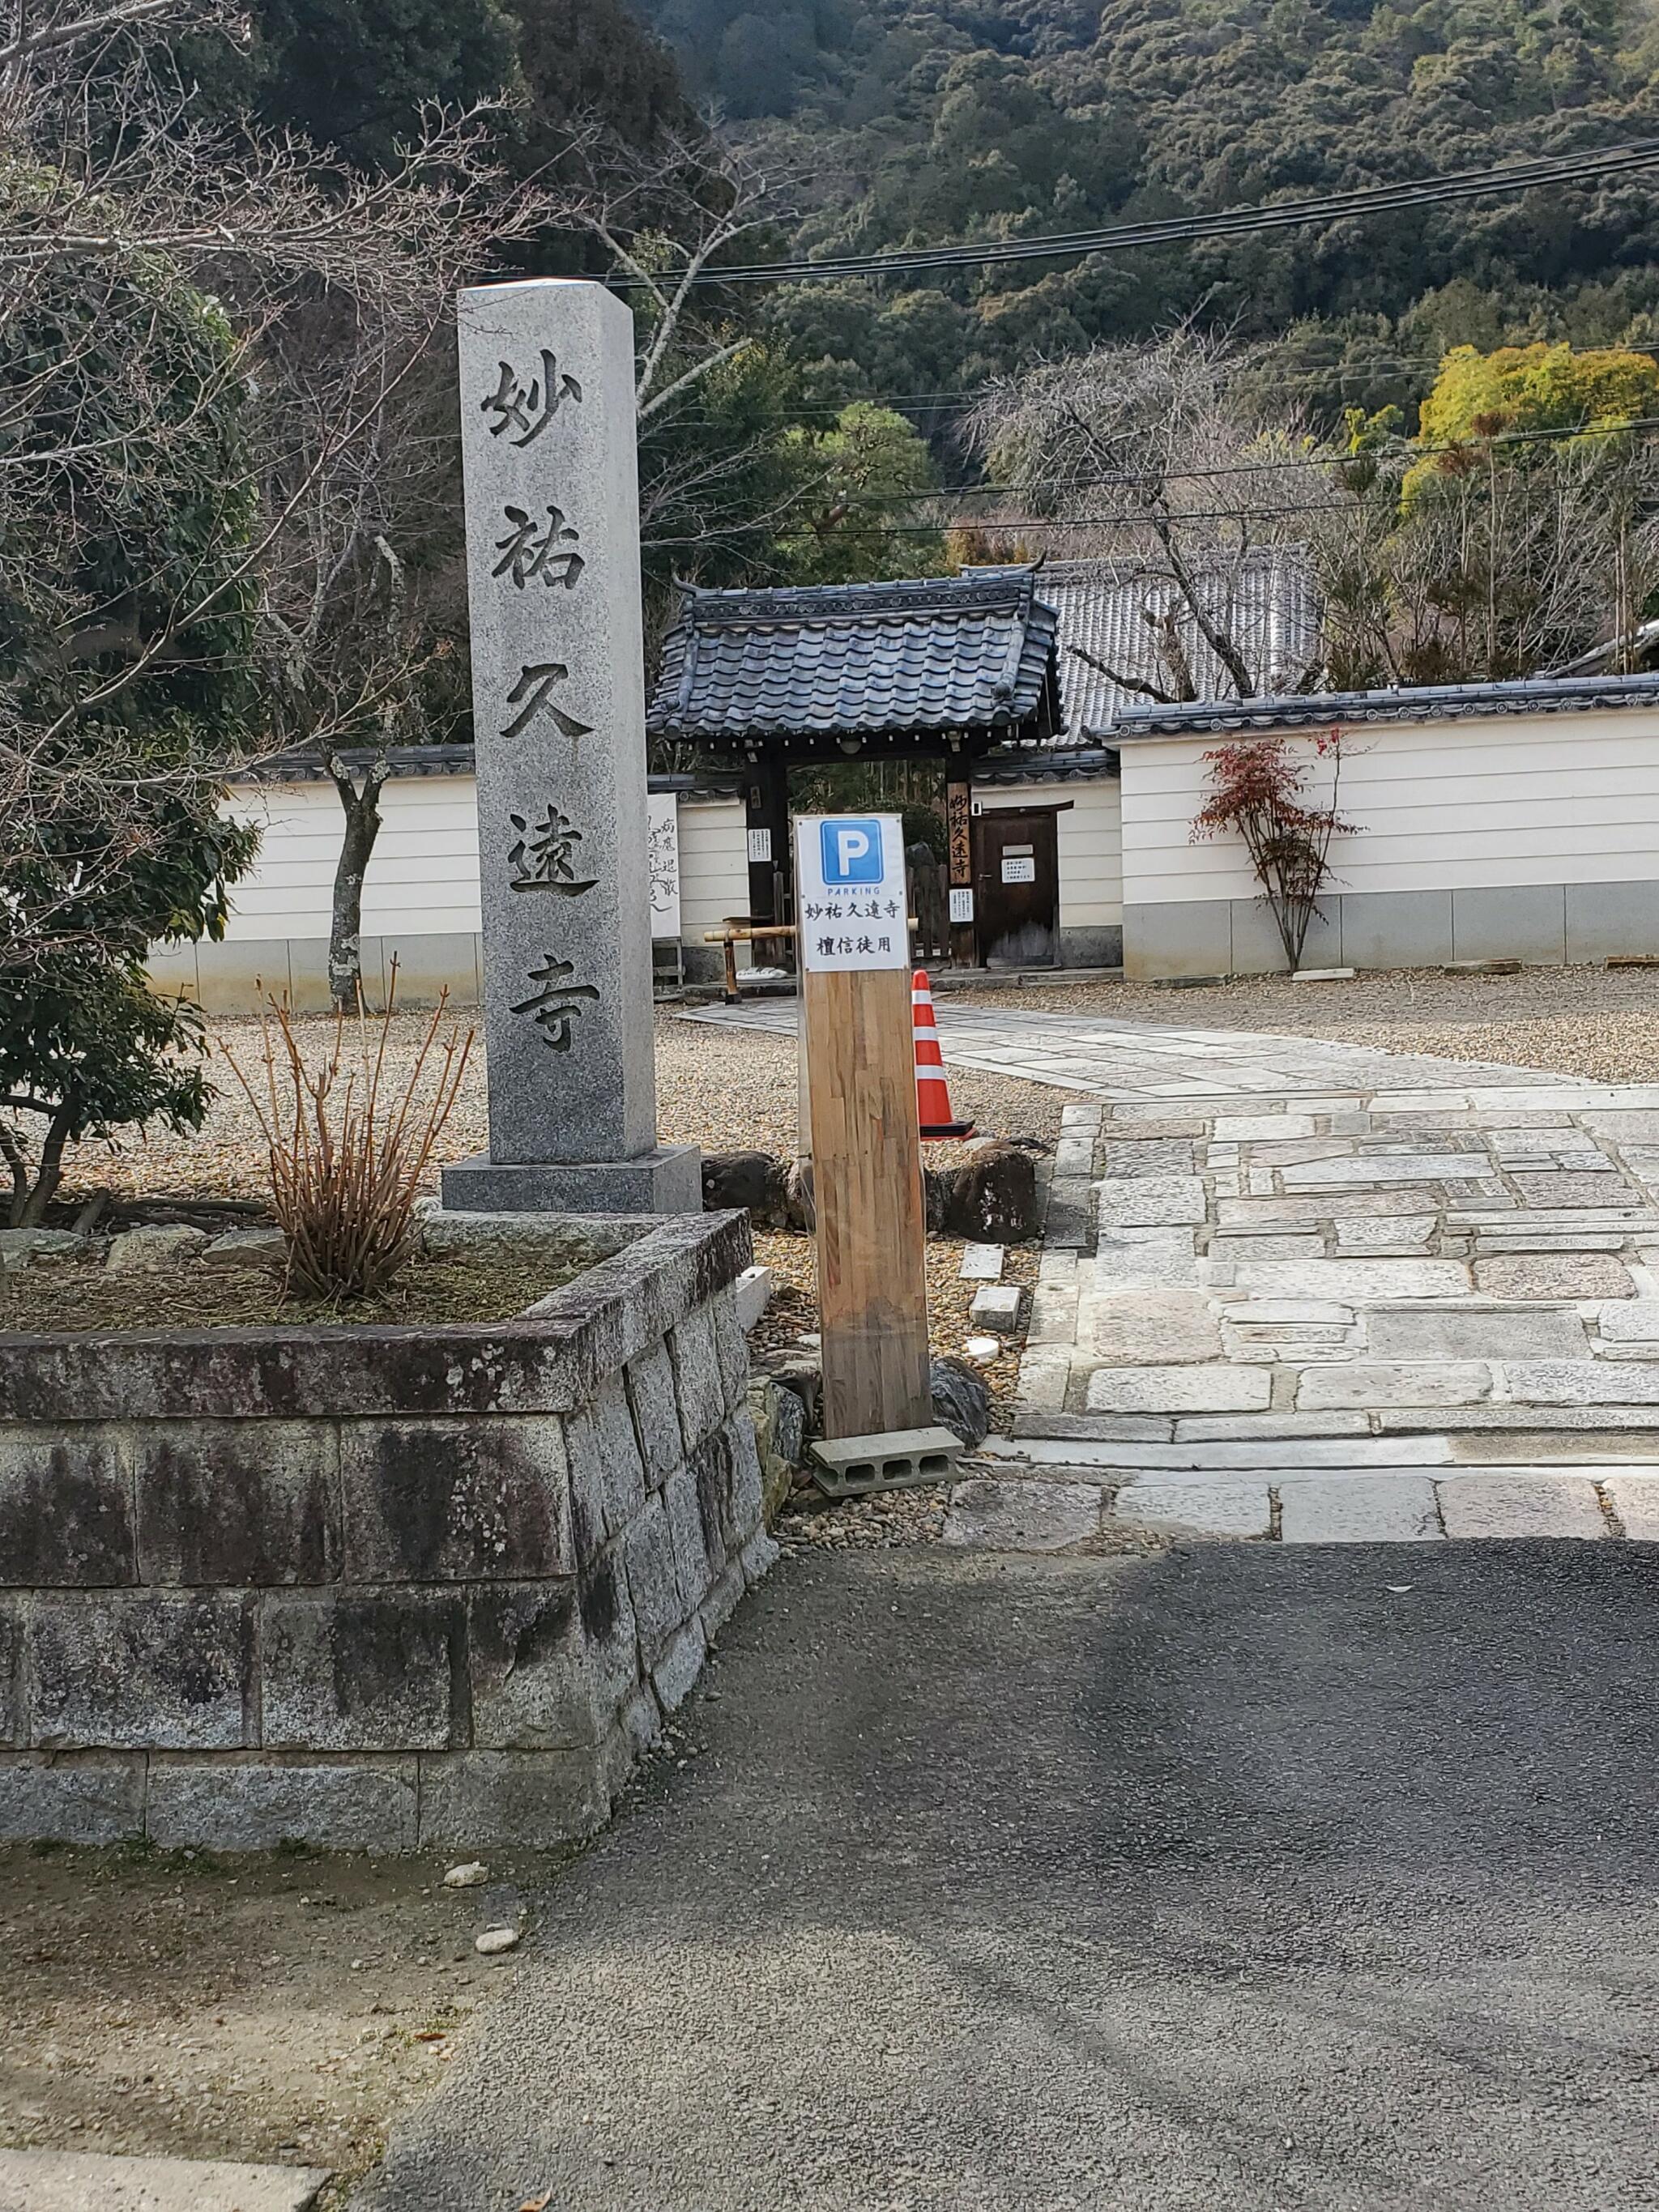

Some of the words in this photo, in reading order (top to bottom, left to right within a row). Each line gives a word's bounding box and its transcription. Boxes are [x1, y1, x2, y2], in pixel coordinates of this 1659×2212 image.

[480, 348, 600, 1052] 妙祐久遠寺
[837, 830, 869, 876] P
[828, 887, 881, 896] PARKING
[804, 900, 901, 921] 妙祐久遠寺
[817, 936, 892, 956] 檀信徒用
